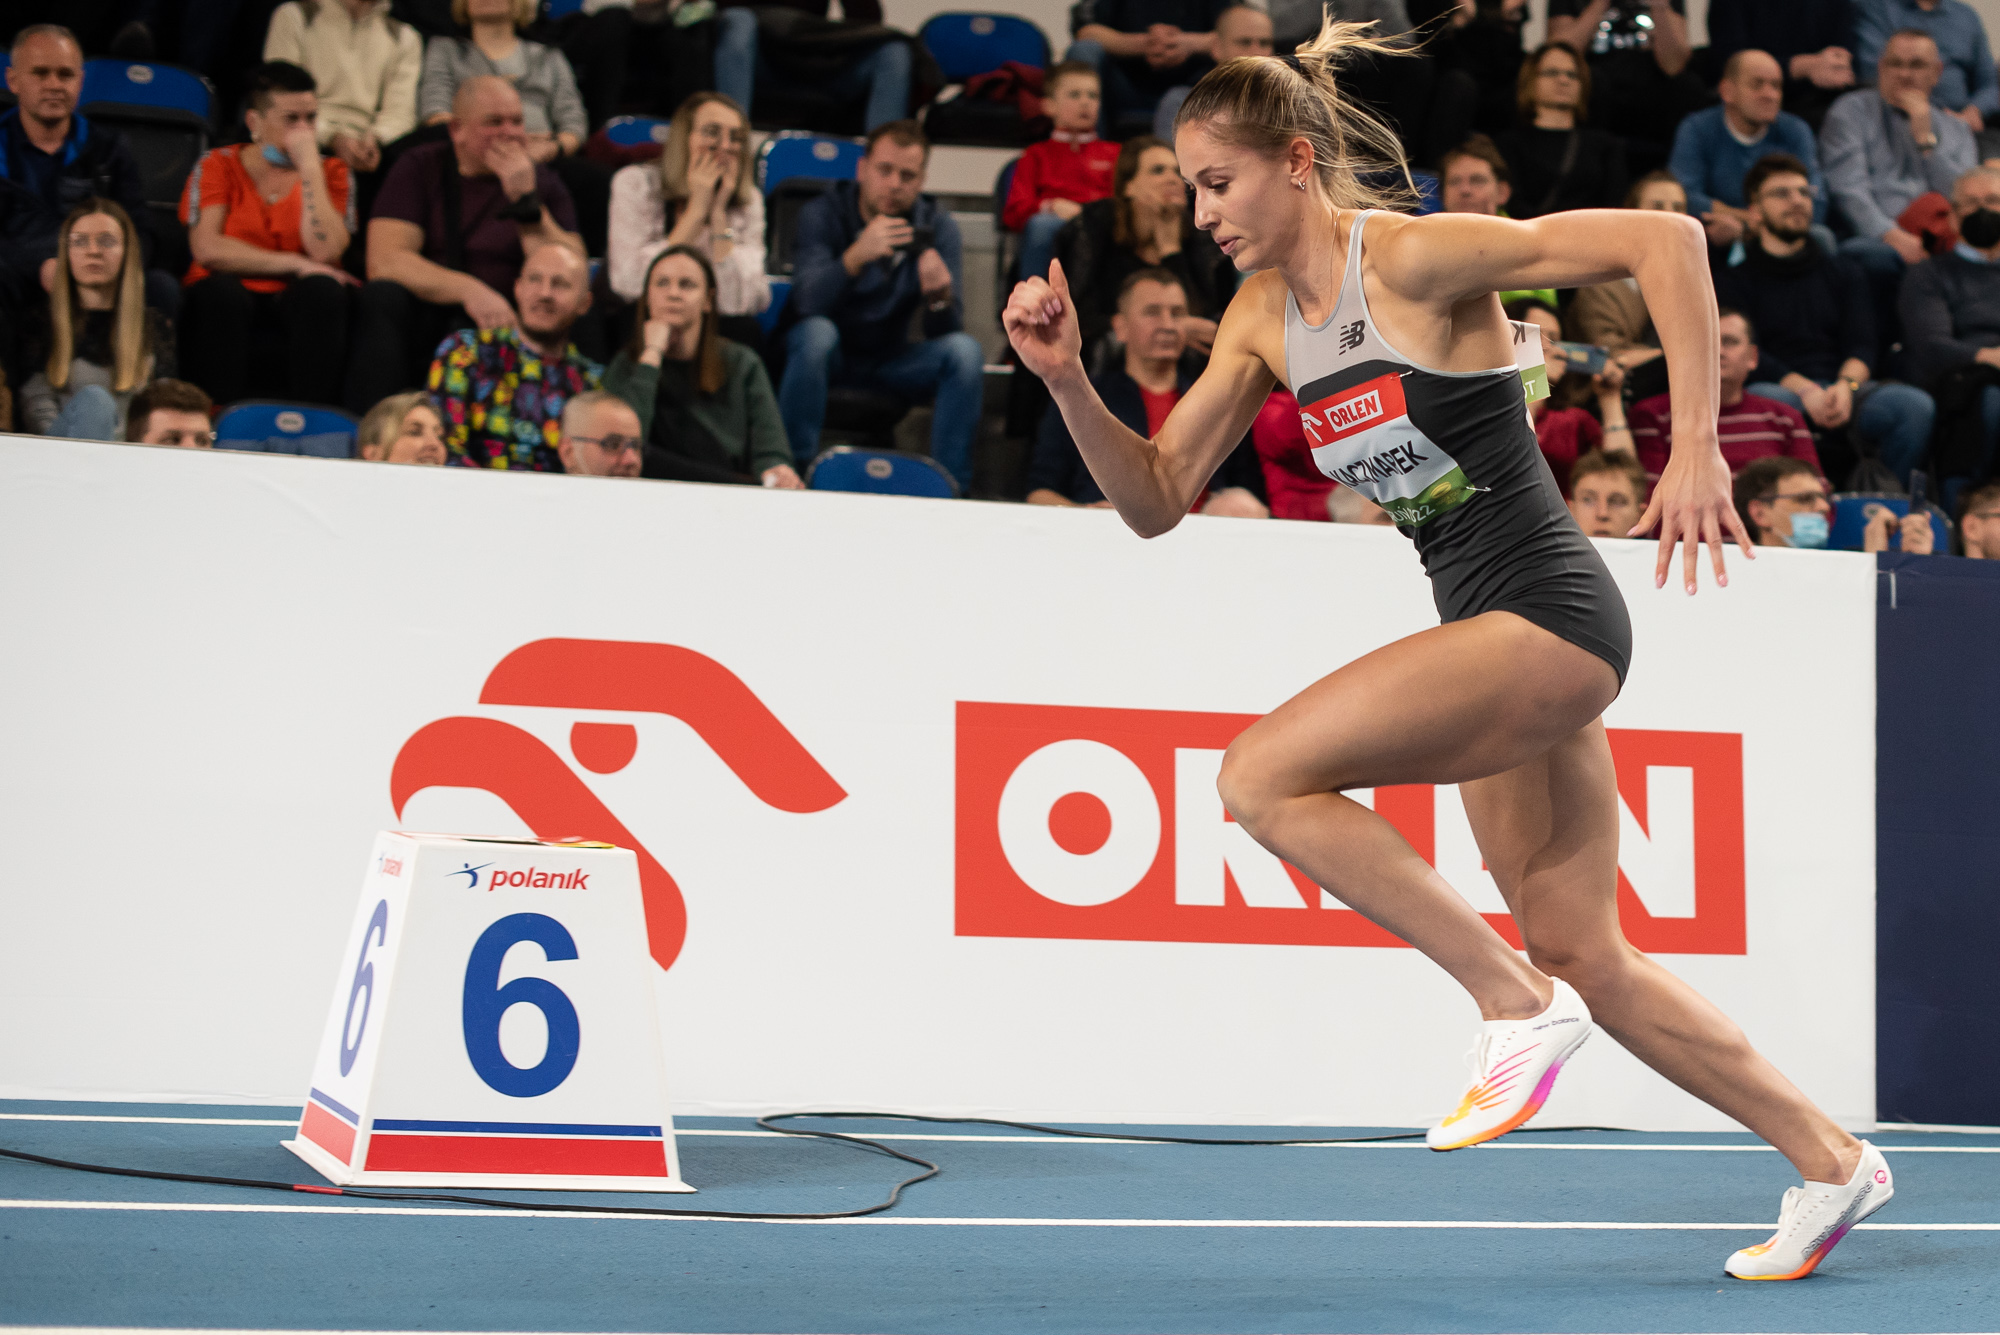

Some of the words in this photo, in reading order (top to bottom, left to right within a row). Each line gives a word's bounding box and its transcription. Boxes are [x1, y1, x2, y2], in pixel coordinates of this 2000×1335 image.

[1329, 395, 1378, 427] ORLEN
[488, 866, 590, 891] polanik
[998, 738, 1695, 919] ORN
[340, 899, 388, 1078] 6
[462, 912, 580, 1098] 6
